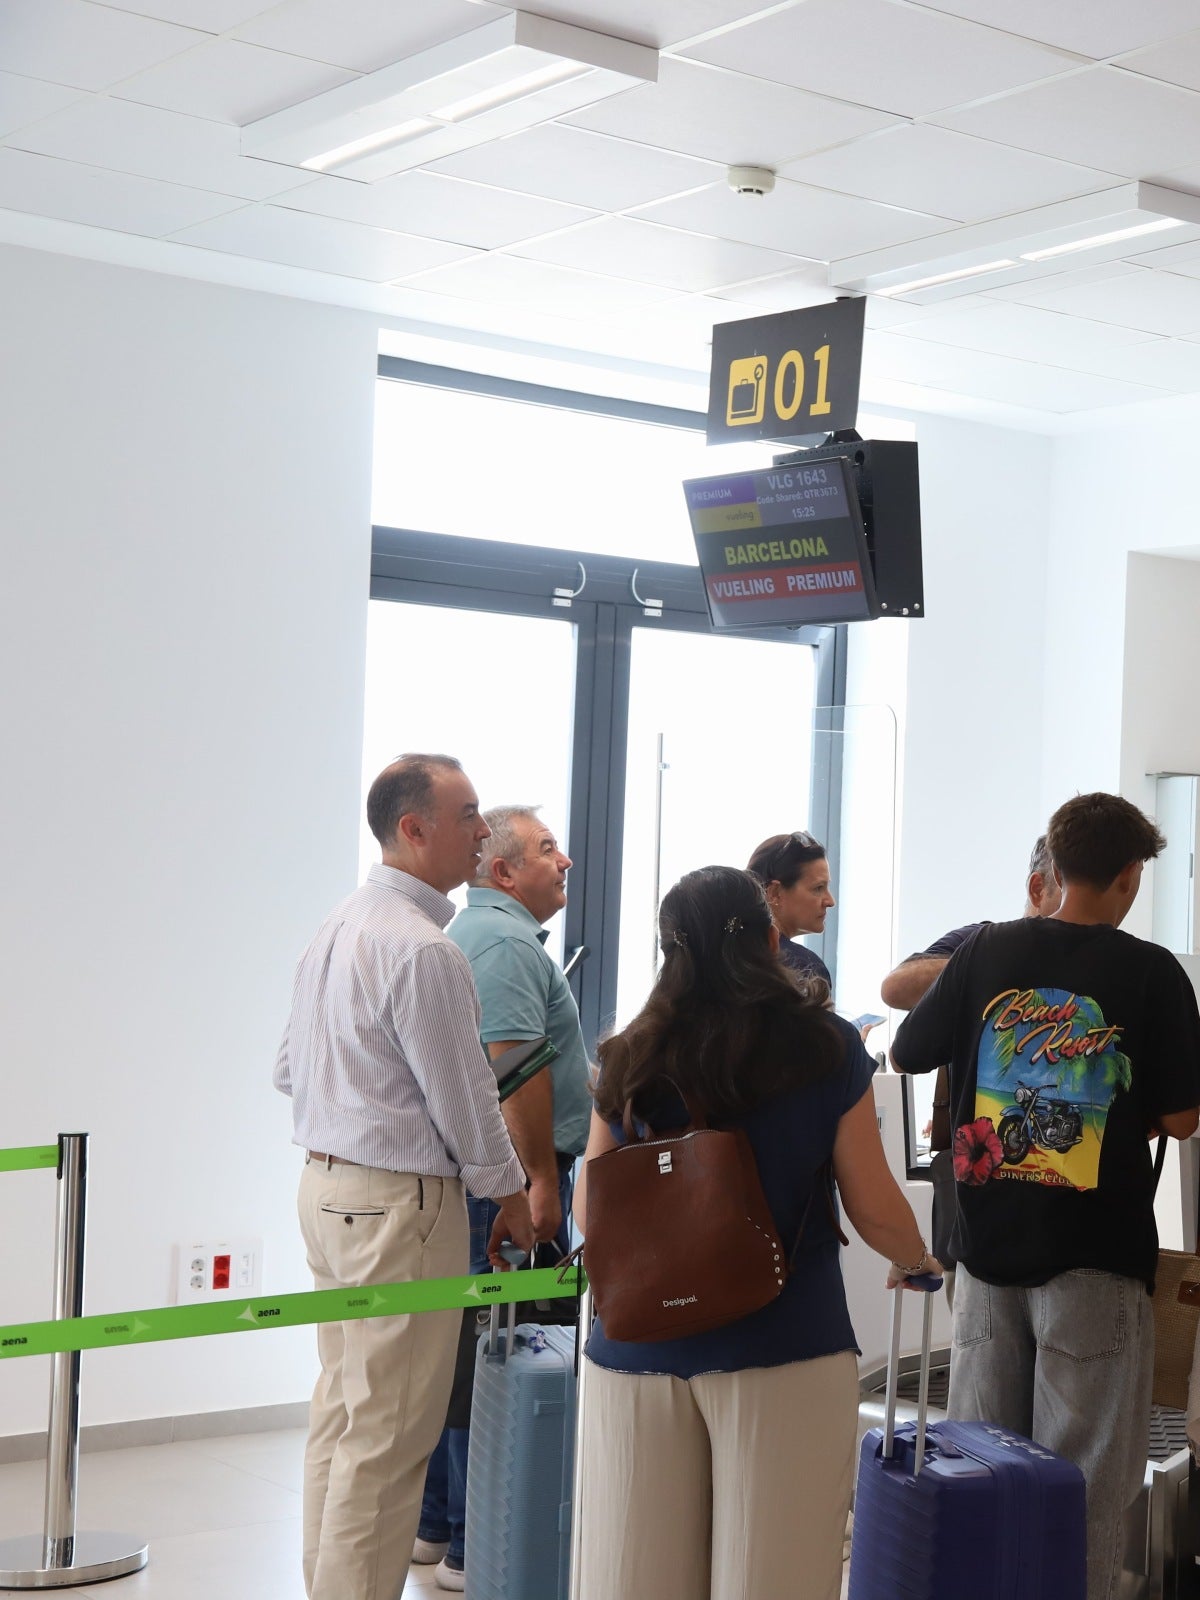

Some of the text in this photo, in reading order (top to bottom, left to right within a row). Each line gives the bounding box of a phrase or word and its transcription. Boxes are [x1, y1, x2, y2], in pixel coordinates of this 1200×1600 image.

[774, 344, 832, 421] 01
[766, 468, 828, 490] VLG 1643
[692, 488, 733, 501] PREMIUM
[756, 495, 775, 504] Code
[792, 506, 816, 519] 15:25
[724, 536, 829, 566] BARCELONA
[713, 569, 857, 598] VUELING PREMIUM
[982, 988, 1080, 1031] Beach
[1015, 1020, 1125, 1065] Resort
[481, 1284, 502, 1294] aena
[662, 1295, 698, 1308] Desigual
[257, 1307, 281, 1317] aena
[1, 1336, 28, 1346] aena
